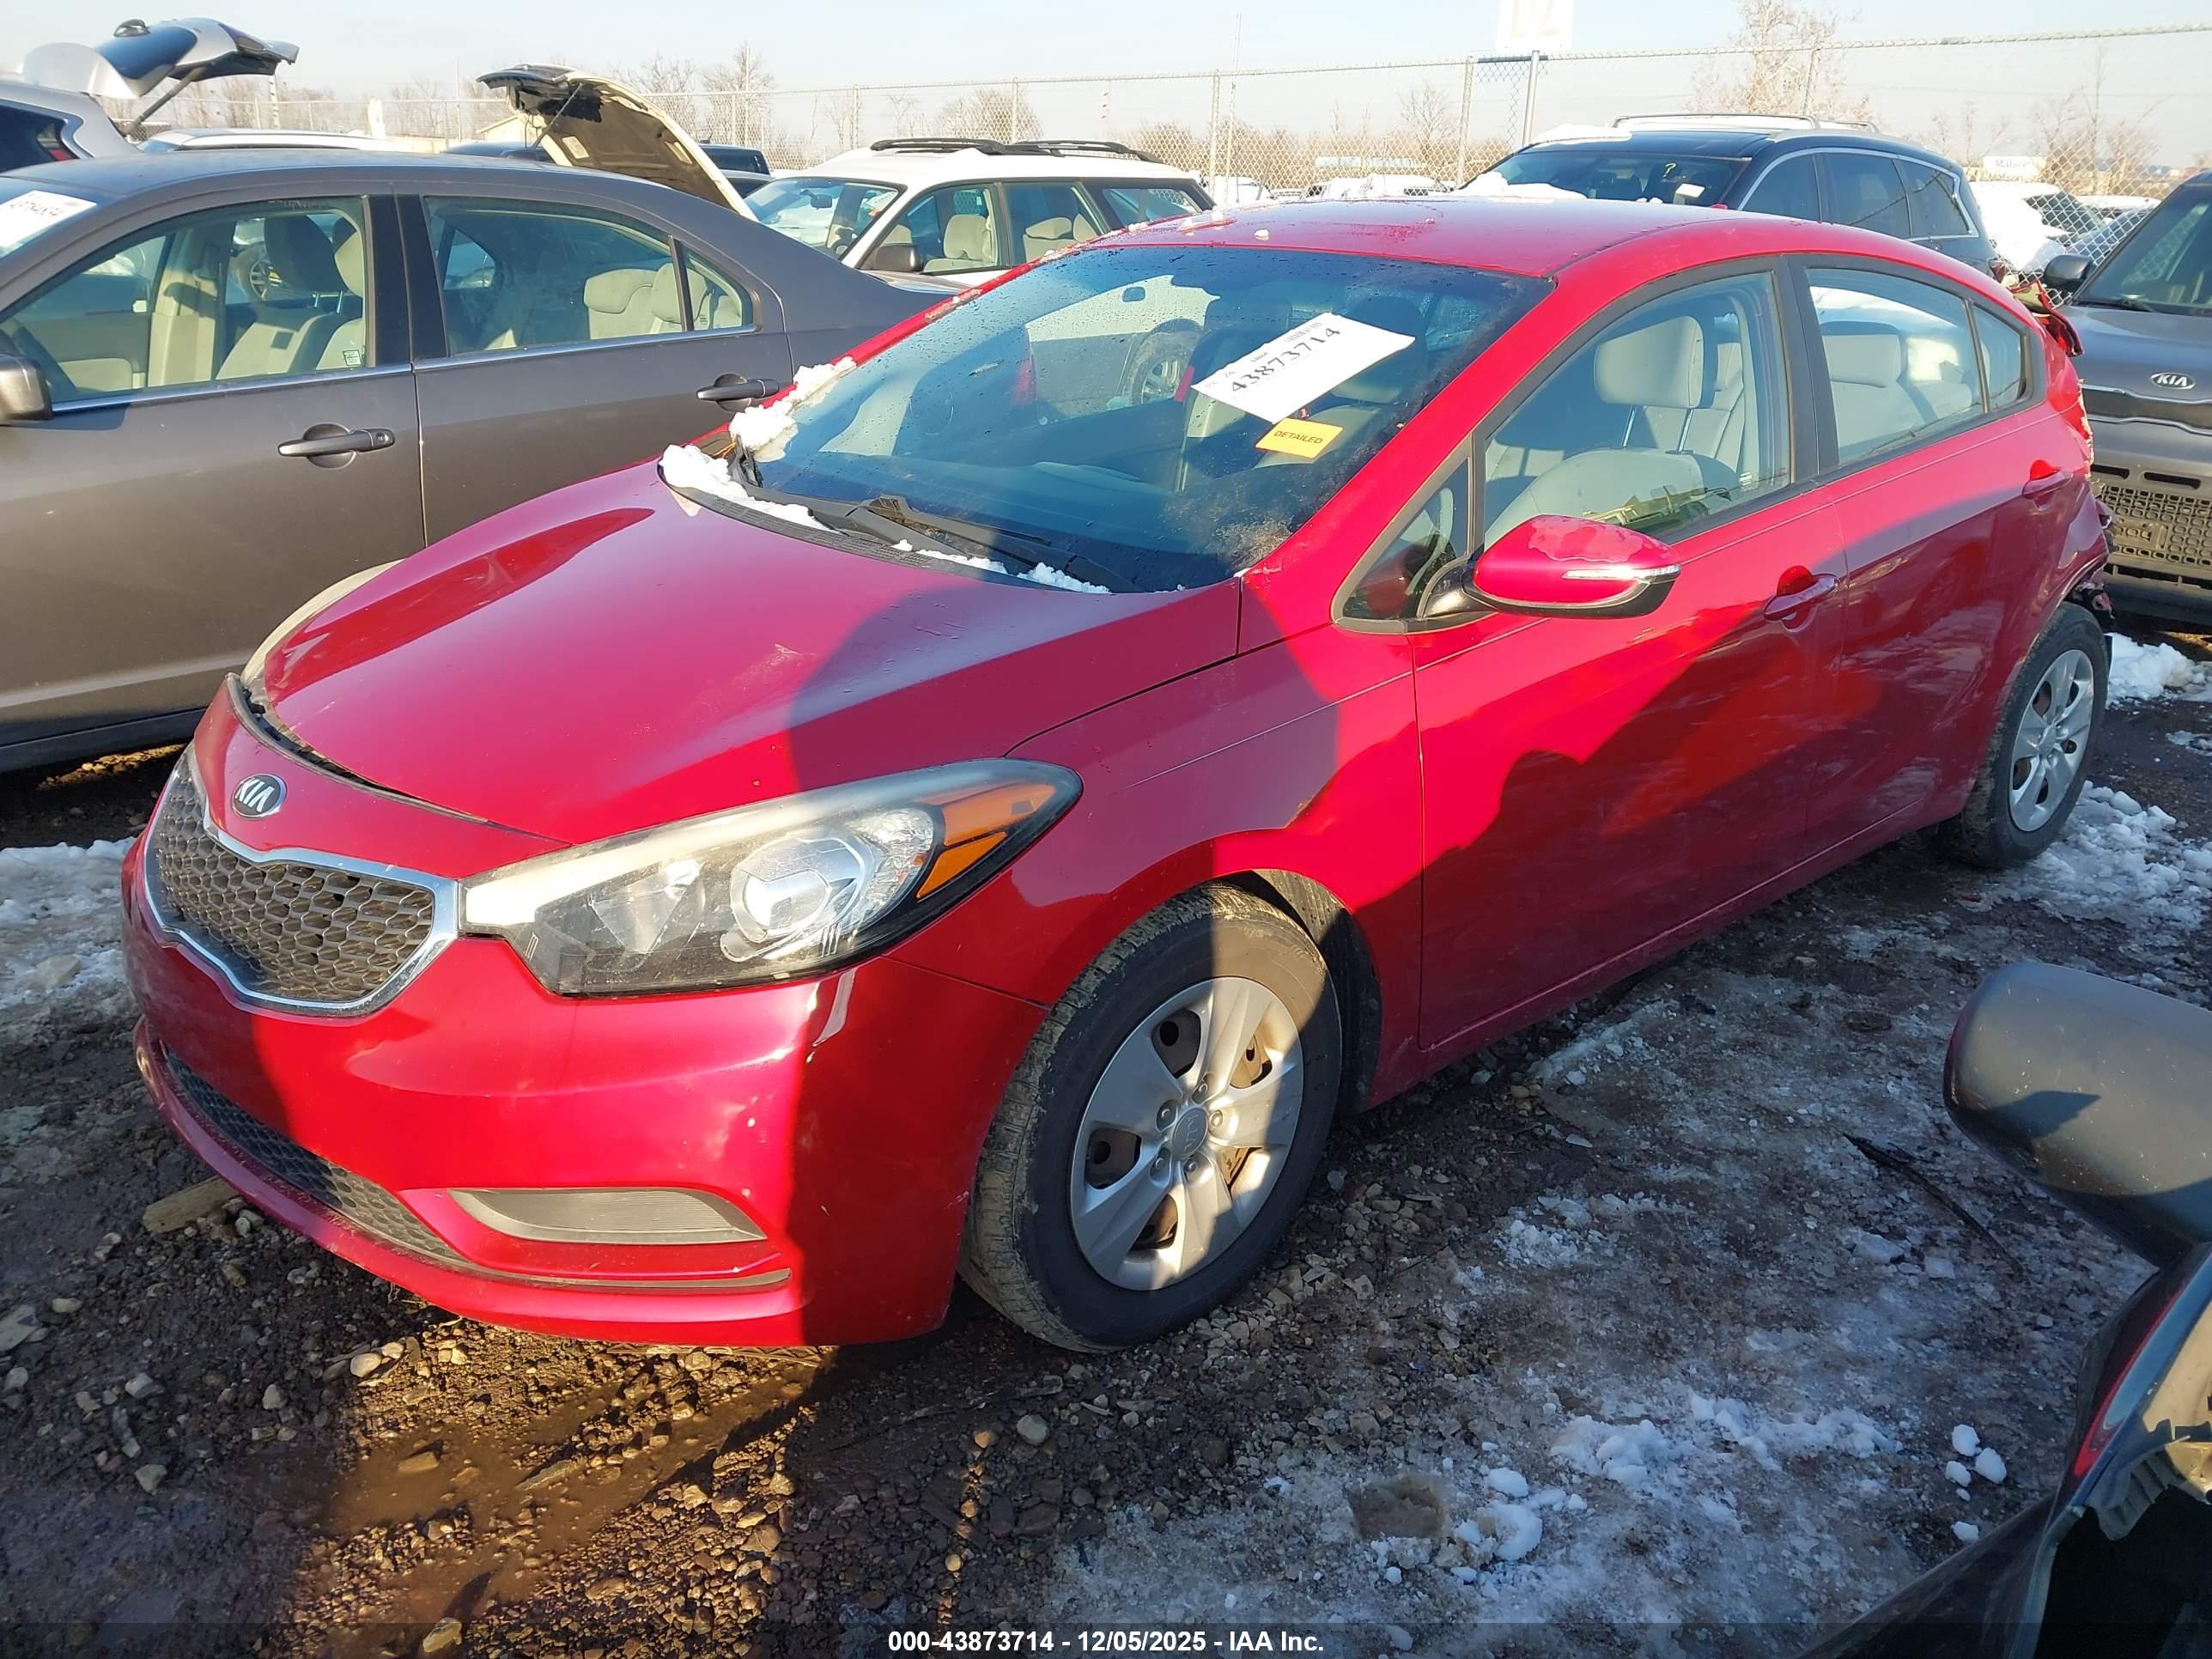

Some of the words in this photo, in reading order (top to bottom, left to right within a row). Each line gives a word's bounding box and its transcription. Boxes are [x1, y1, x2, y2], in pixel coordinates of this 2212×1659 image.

[1231, 327, 1341, 392] 43873714
[2156, 374, 2188, 386] KIA
[1273, 429, 1324, 445] DETAILED
[234, 777, 276, 813] KIA
